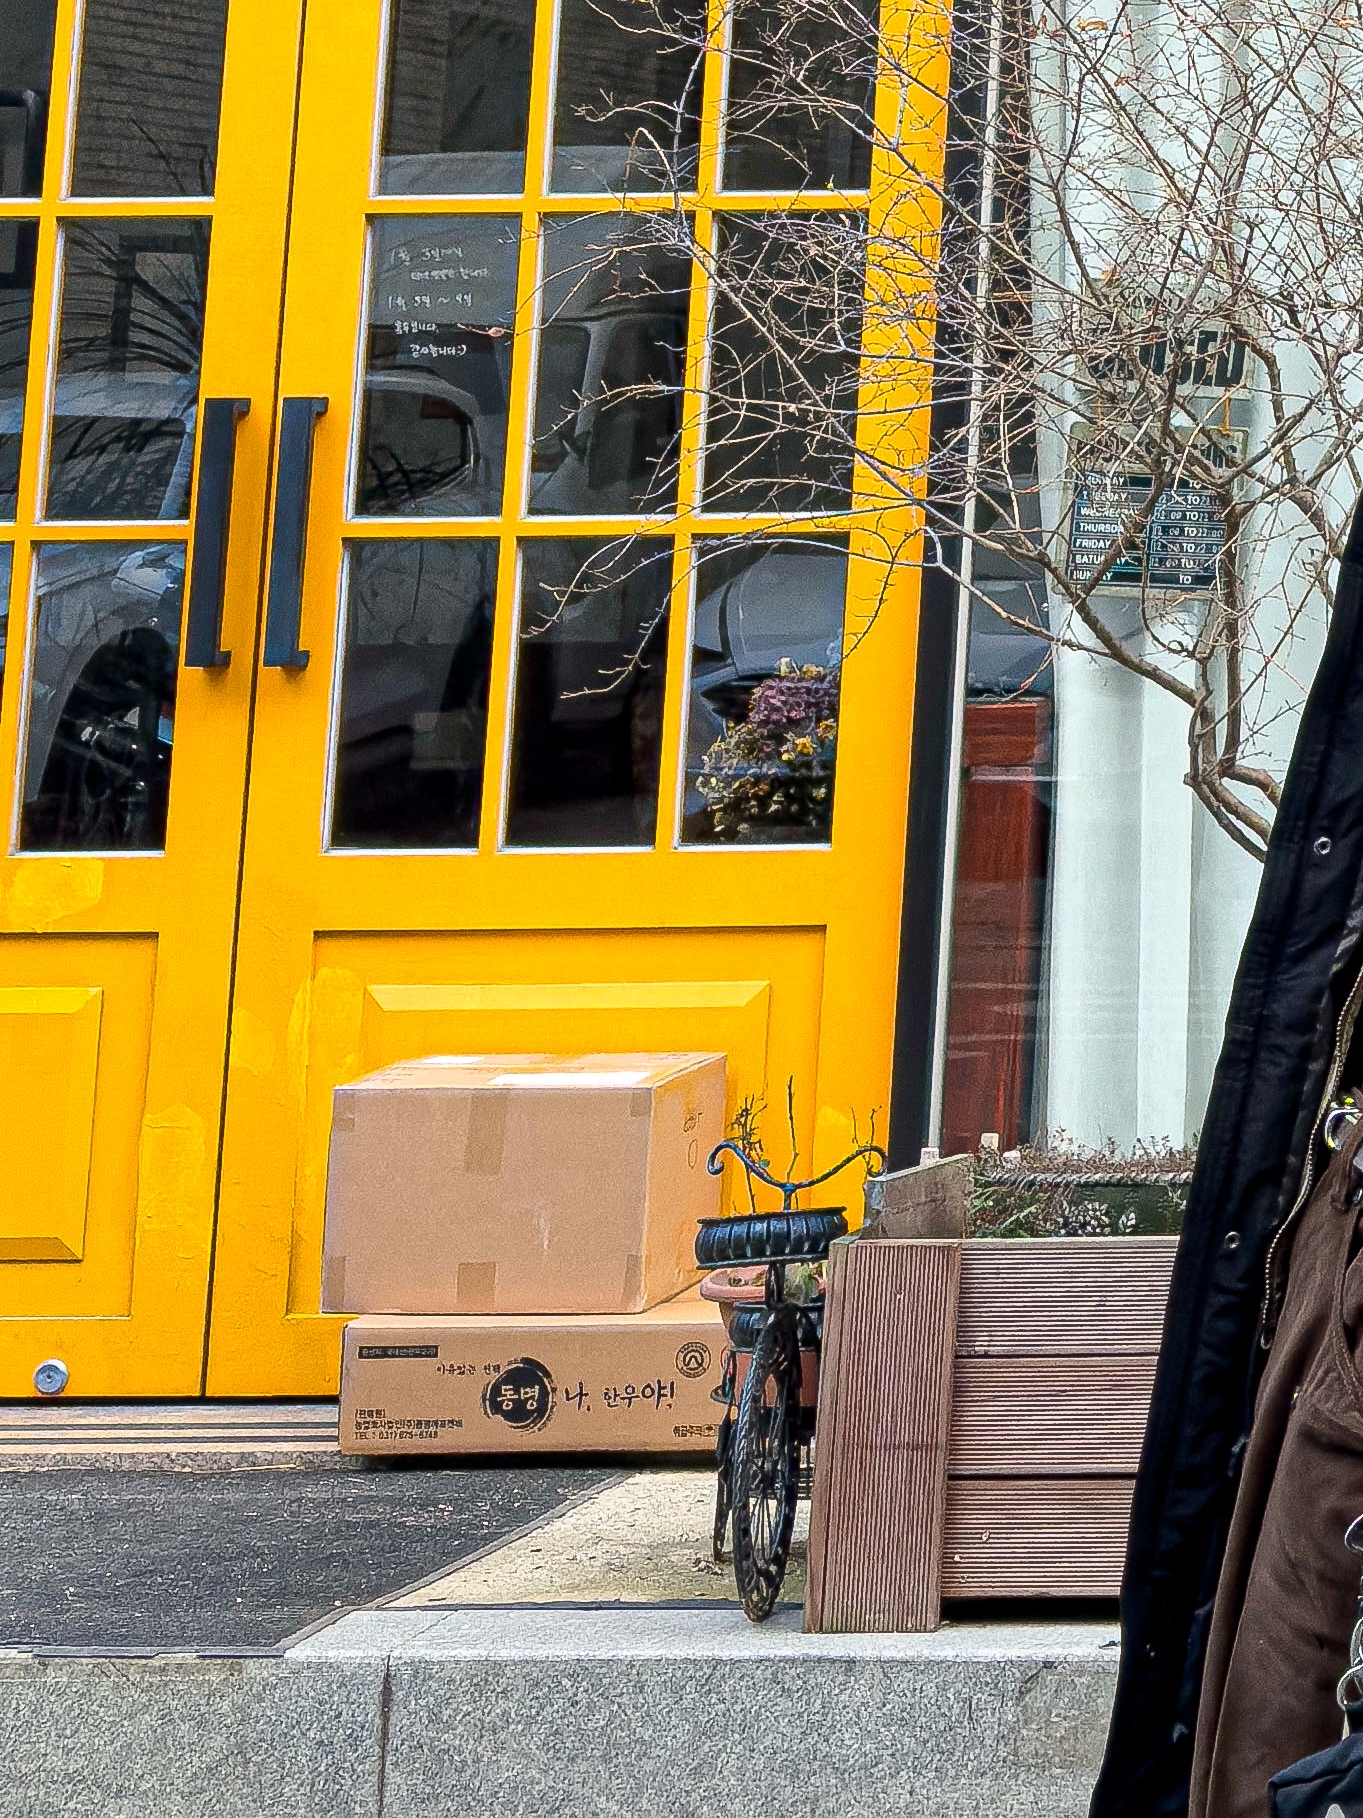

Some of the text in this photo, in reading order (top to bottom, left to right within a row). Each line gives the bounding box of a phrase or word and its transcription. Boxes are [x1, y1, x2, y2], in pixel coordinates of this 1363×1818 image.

[1187, 495, 1200, 505] TO
[1185, 511, 1198, 521] TO
[1184, 527, 1197, 536] TO
[1075, 538, 1111, 549] FRIDAY
[1182, 543, 1195, 553] TO
[1180, 559, 1194, 569] TO
[1179, 574, 1192, 584] TO
[496, 1384, 540, 1411] 동명
[603, 1378, 676, 1411] 한우야!
